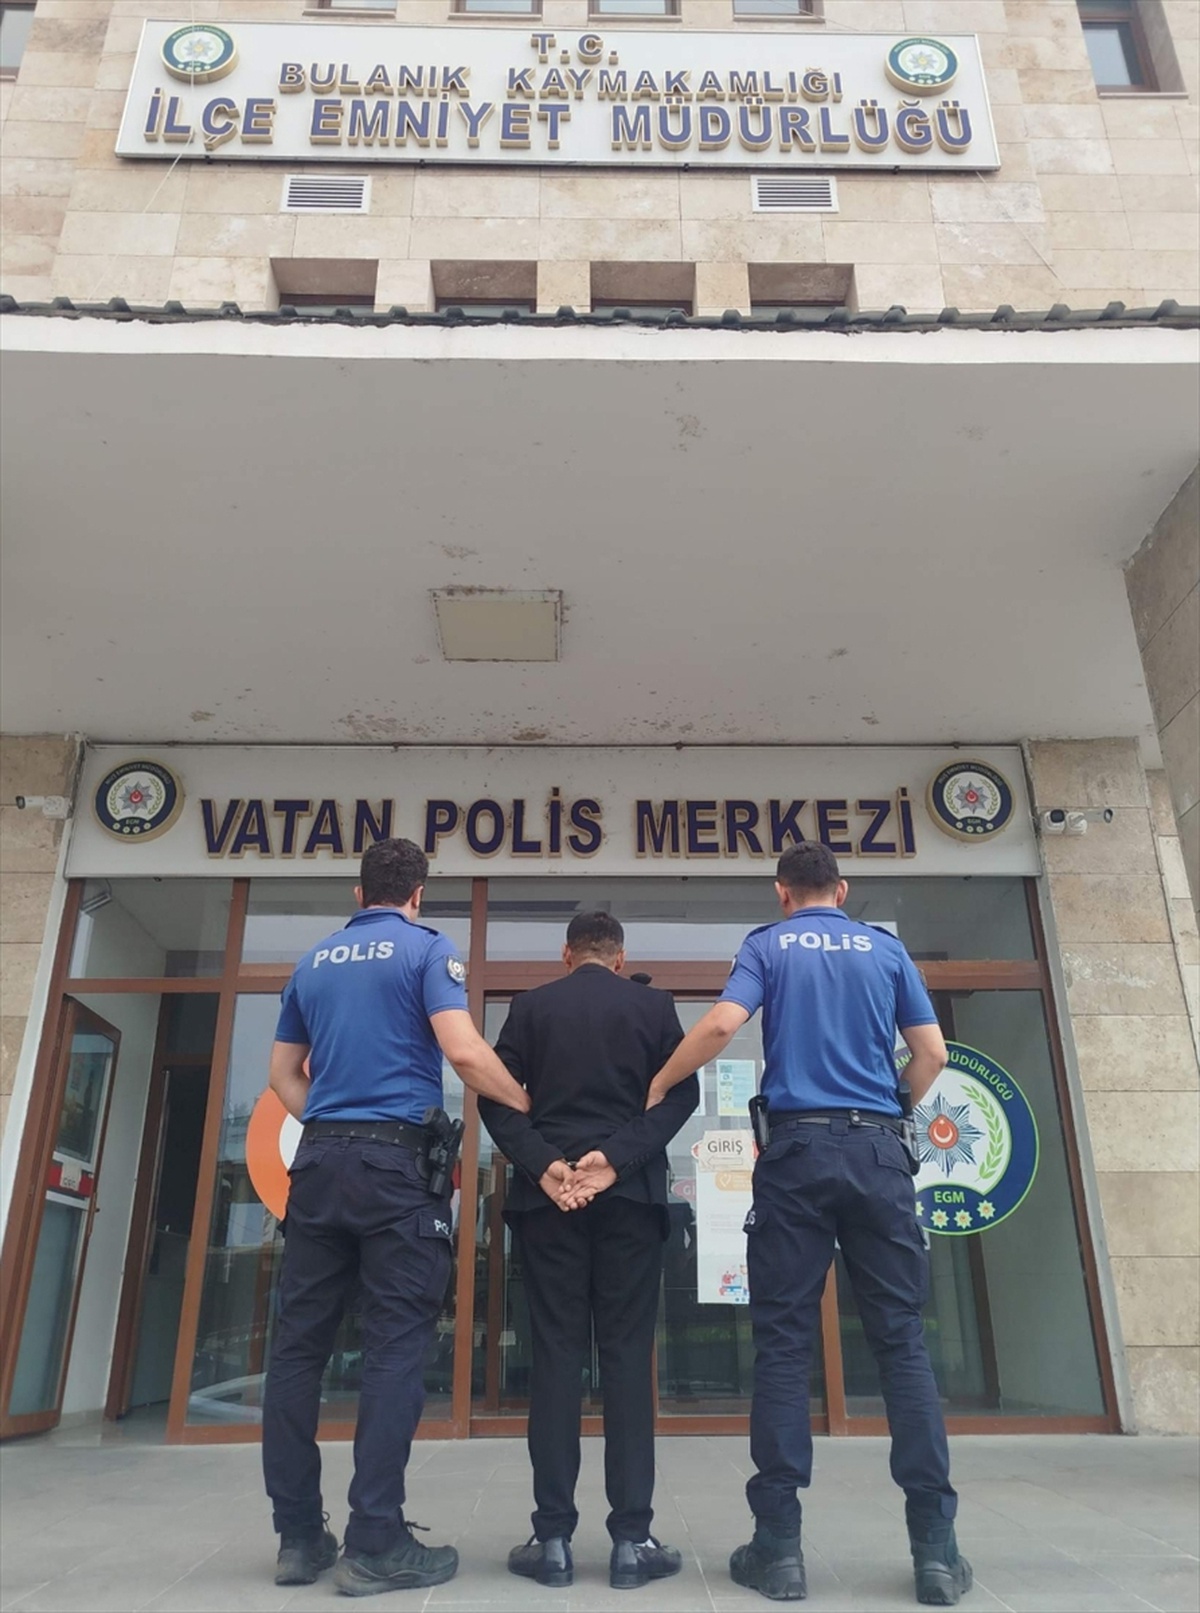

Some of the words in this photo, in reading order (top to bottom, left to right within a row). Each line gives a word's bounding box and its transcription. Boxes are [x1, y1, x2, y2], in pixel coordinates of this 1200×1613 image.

[531, 33, 619, 63] T.C.
[279, 63, 469, 96] BULANIK
[507, 67, 843, 100] KAYMAKAMLIĞI
[145, 87, 276, 149] İLÇE
[311, 92, 571, 149] EMNİYET
[611, 97, 973, 153] MÜDÜRLÜĞÜ
[200, 799, 394, 857] VATAN
[425, 787, 603, 858] POLİS
[635, 787, 917, 858] MERKEZİ
[707, 1138, 743, 1155] GİRİŞ
[934, 1191, 965, 1203] EGM
